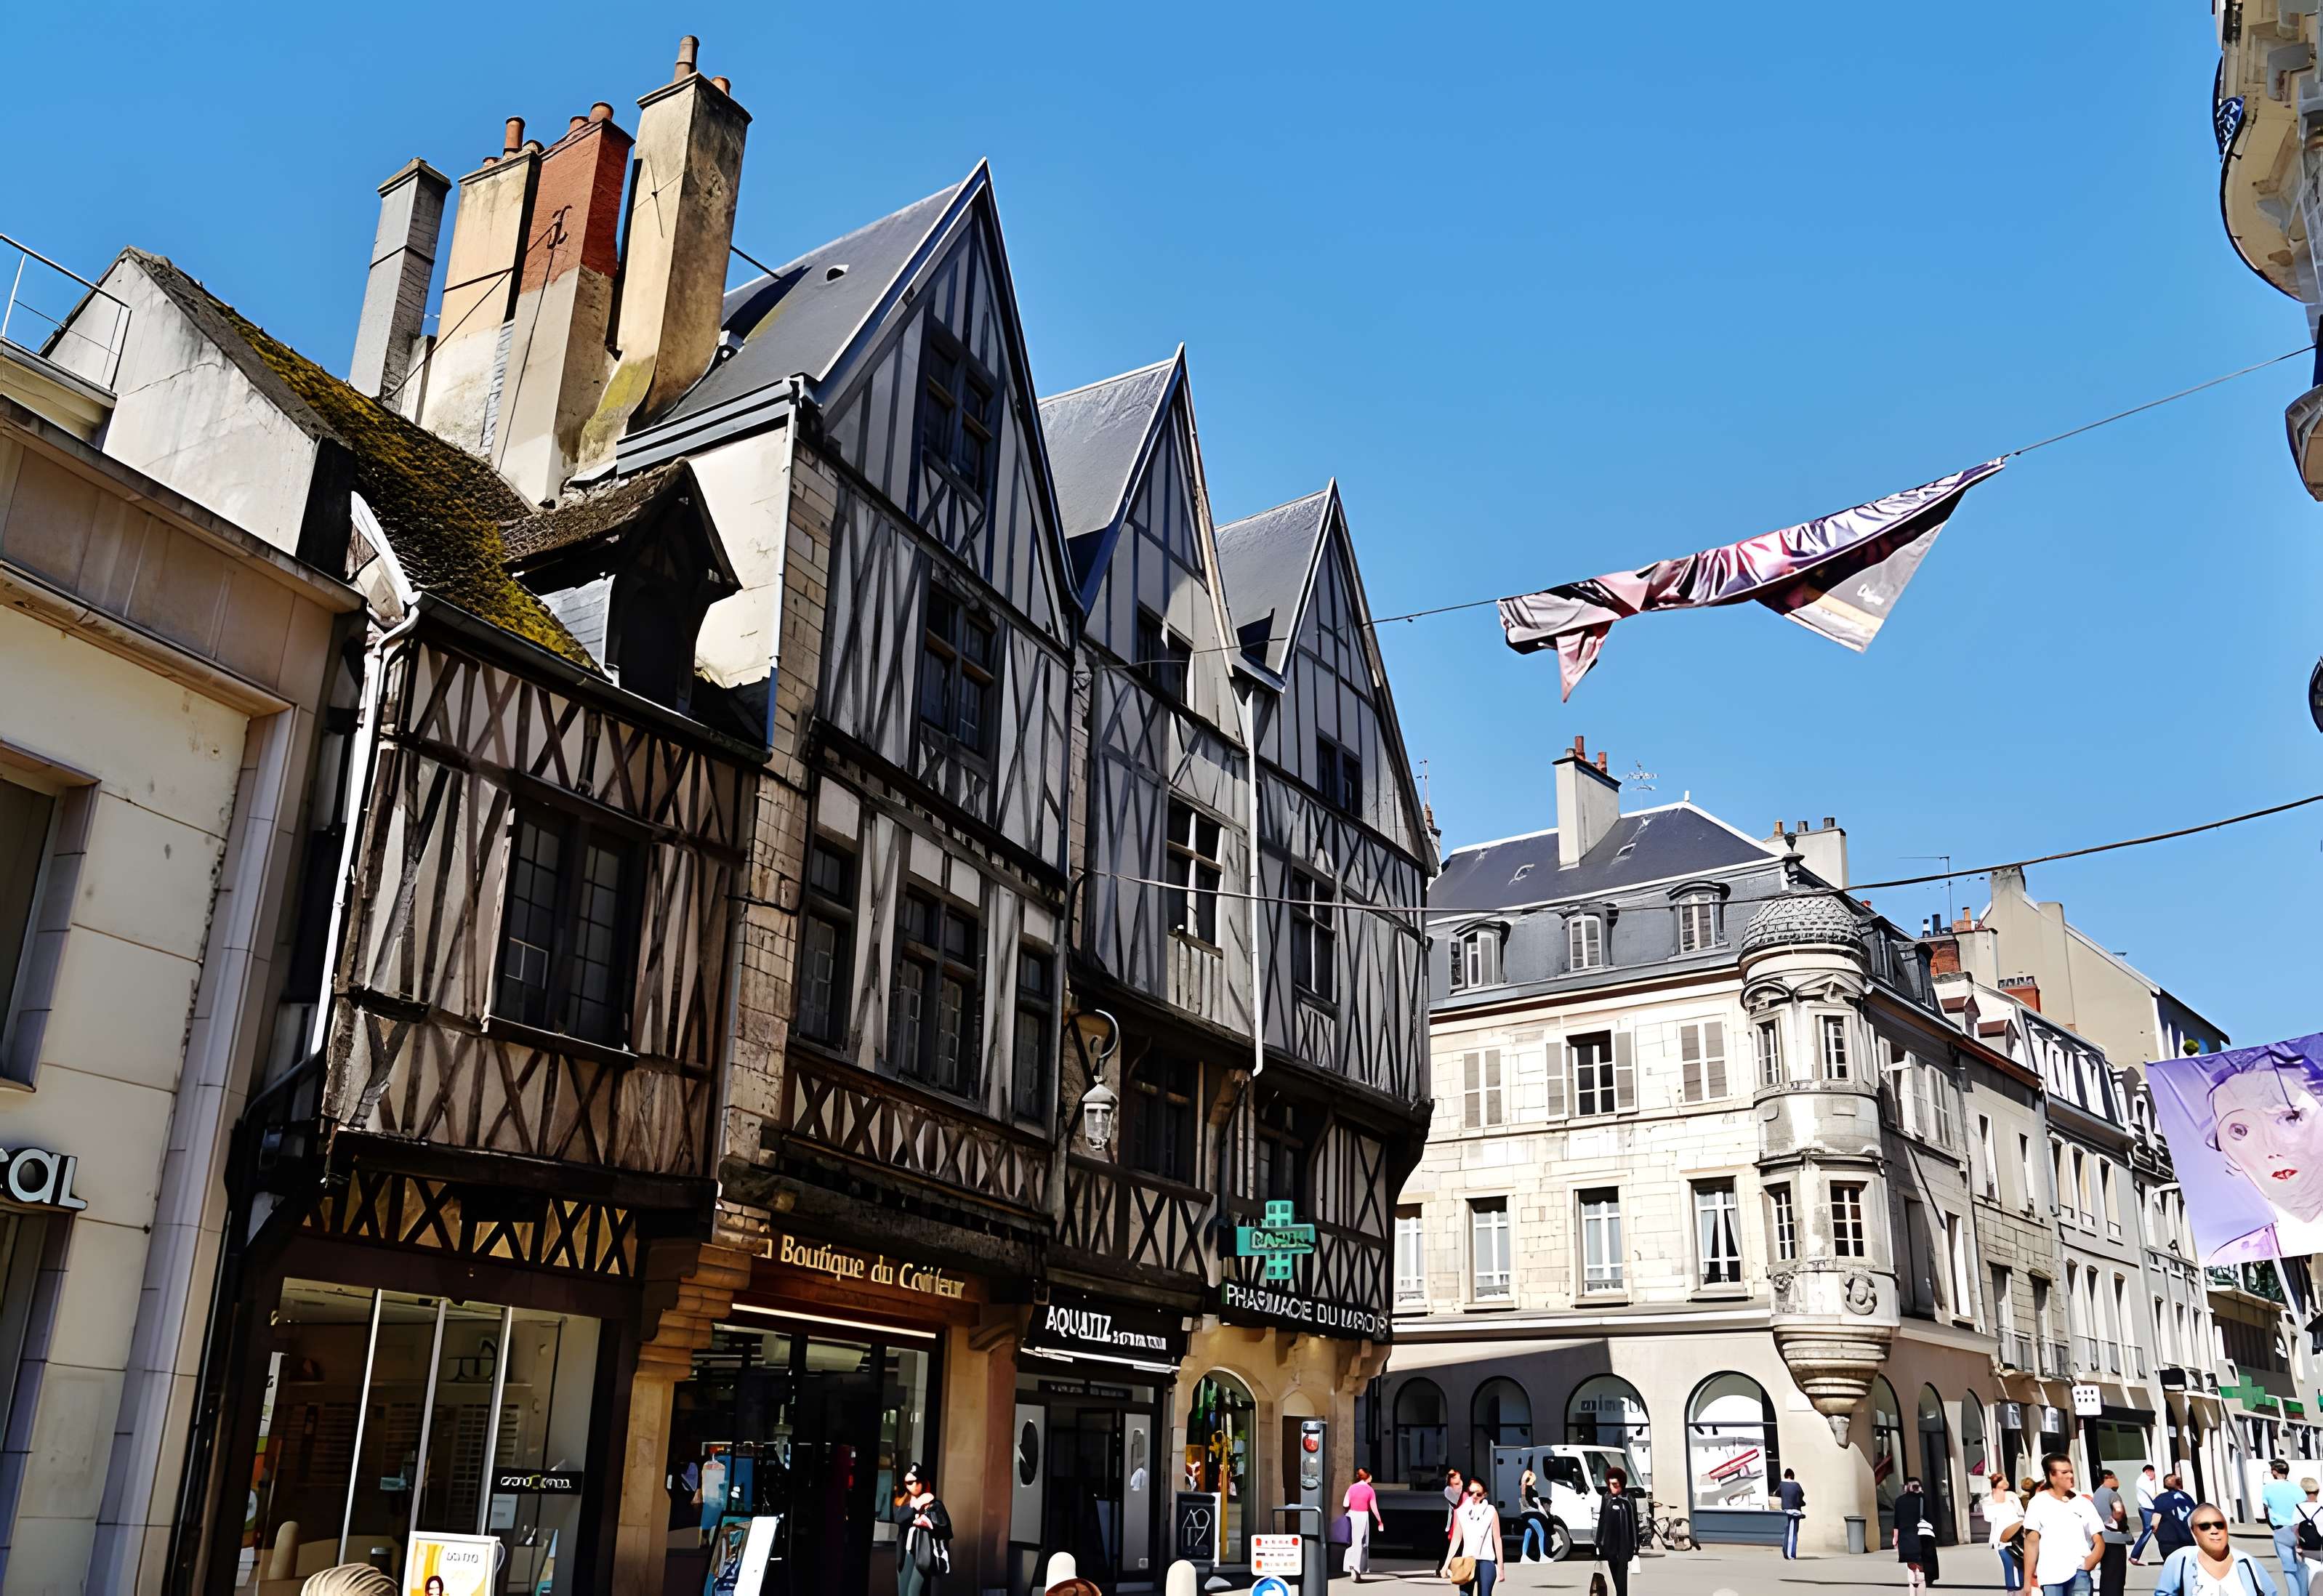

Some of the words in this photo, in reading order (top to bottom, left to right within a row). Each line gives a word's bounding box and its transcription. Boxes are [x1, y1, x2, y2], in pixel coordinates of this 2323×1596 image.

[781, 1235, 865, 1281] Boutique
[871, 1255, 893, 1285] du
[1317, 1303, 1337, 1326] DU
